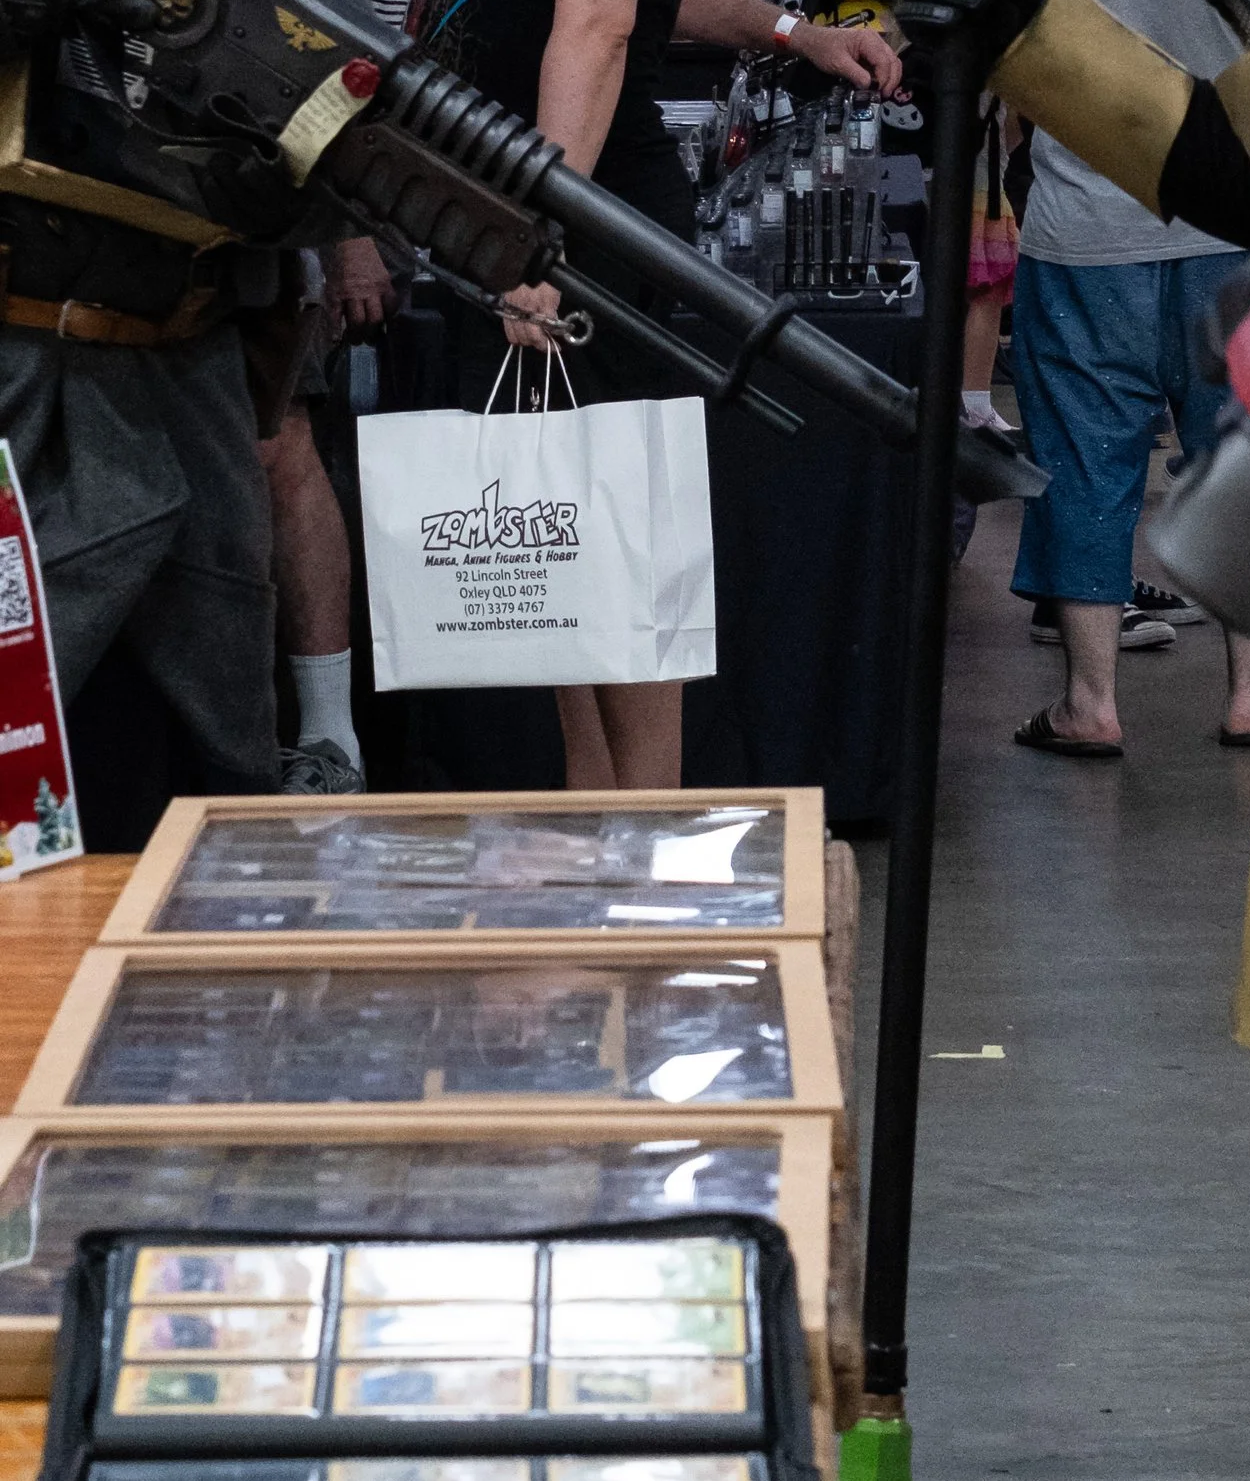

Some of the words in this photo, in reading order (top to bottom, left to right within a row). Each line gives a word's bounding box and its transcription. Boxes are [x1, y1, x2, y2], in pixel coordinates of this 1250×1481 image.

[495, 552, 531, 564] FIGURES
[535, 550, 543, 564] &
[546, 550, 579, 562] HOBBY
[455, 570, 469, 582] 92
[471, 569, 511, 582] Lincoln
[514, 568, 548, 580] Street
[460, 586, 490, 601] Oxley
[492, 585, 517, 598] QLD
[520, 584, 547, 597] 4075
[464, 603, 485, 617] (07)
[488, 602, 515, 615] 3379
[518, 601, 545, 613] 4767
[436, 617, 578, 633] www.zombster.com.au
